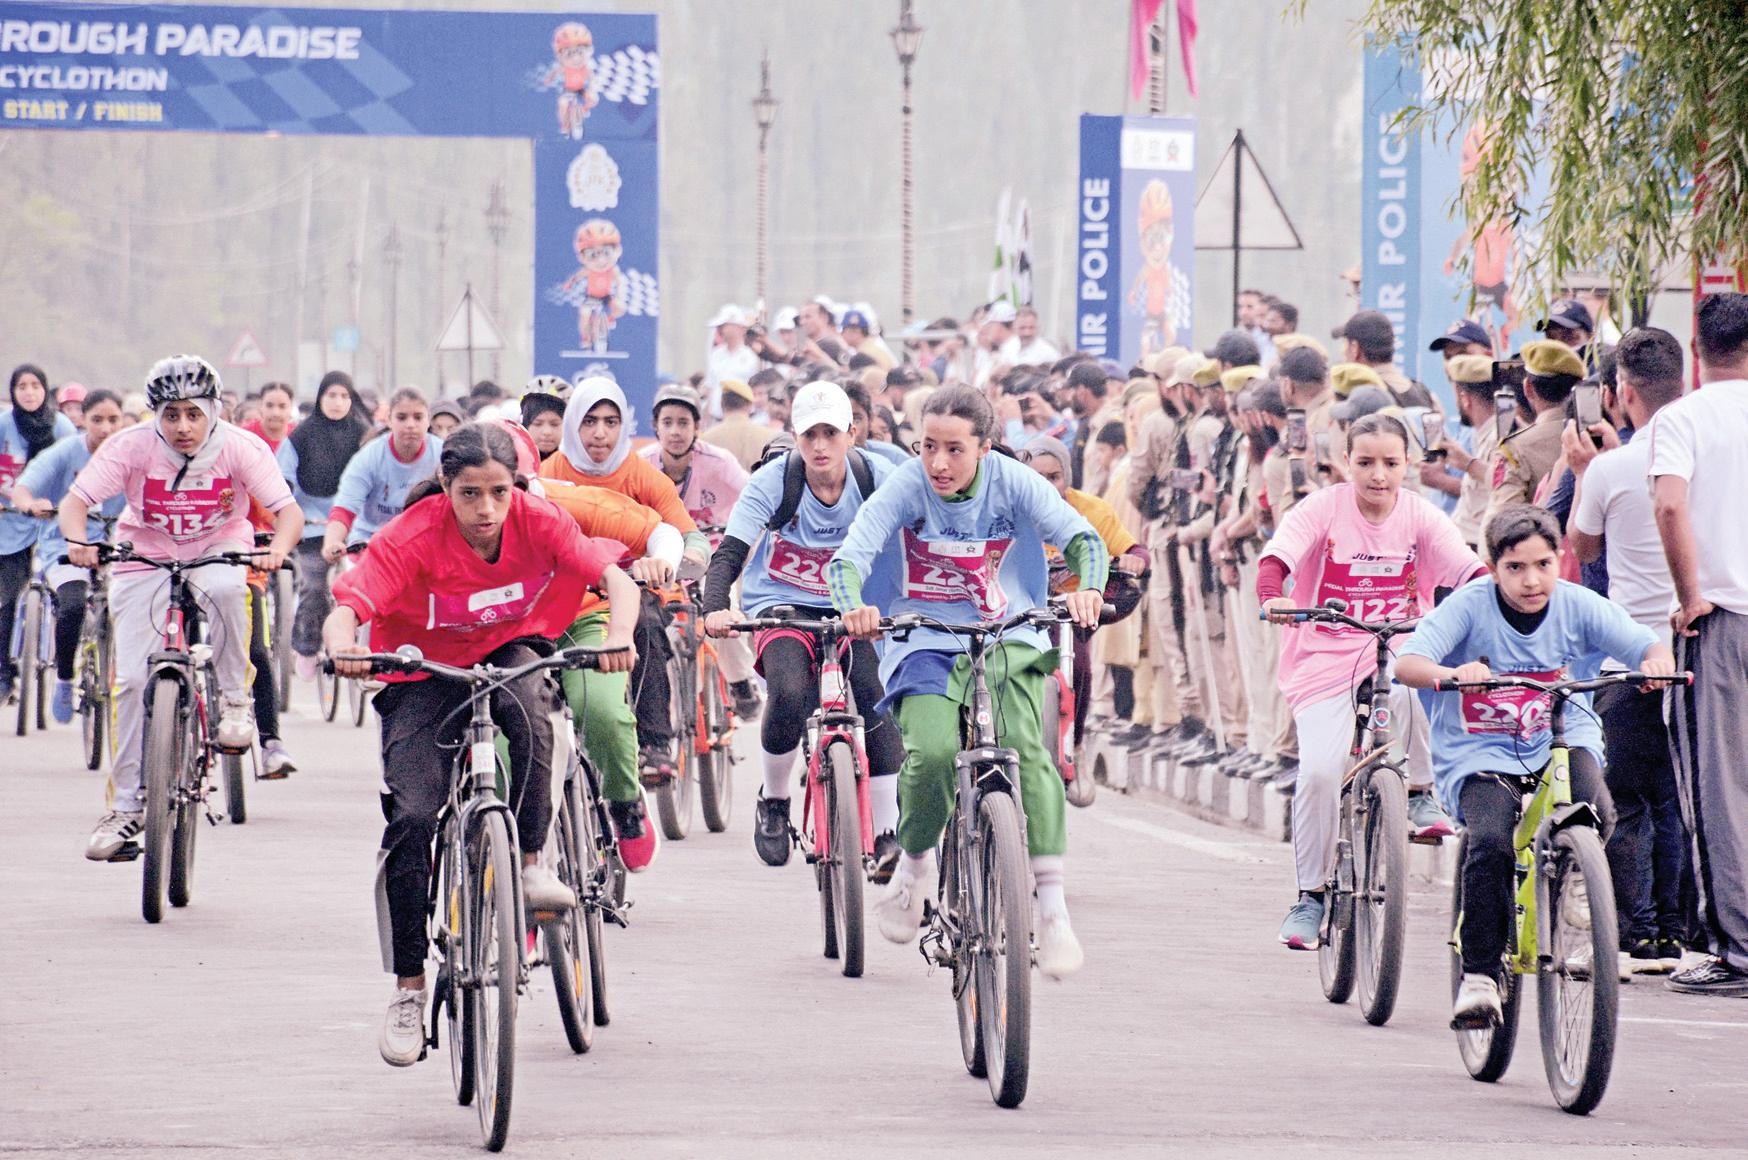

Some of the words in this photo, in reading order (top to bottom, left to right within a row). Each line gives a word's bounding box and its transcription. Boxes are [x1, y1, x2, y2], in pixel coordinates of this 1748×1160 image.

[0, 20, 148, 55] ROUGH
[155, 23, 362, 60] PARADISE
[0, 64, 168, 91] CYCLOTHON
[4, 99, 69, 120] START
[93, 102, 163, 122] FINISH
[1378, 110, 1408, 265] POLICE
[1081, 178, 1110, 300] POLICE
[813, 527, 842, 535] JUST
[1352, 552, 1384, 561] JUST
